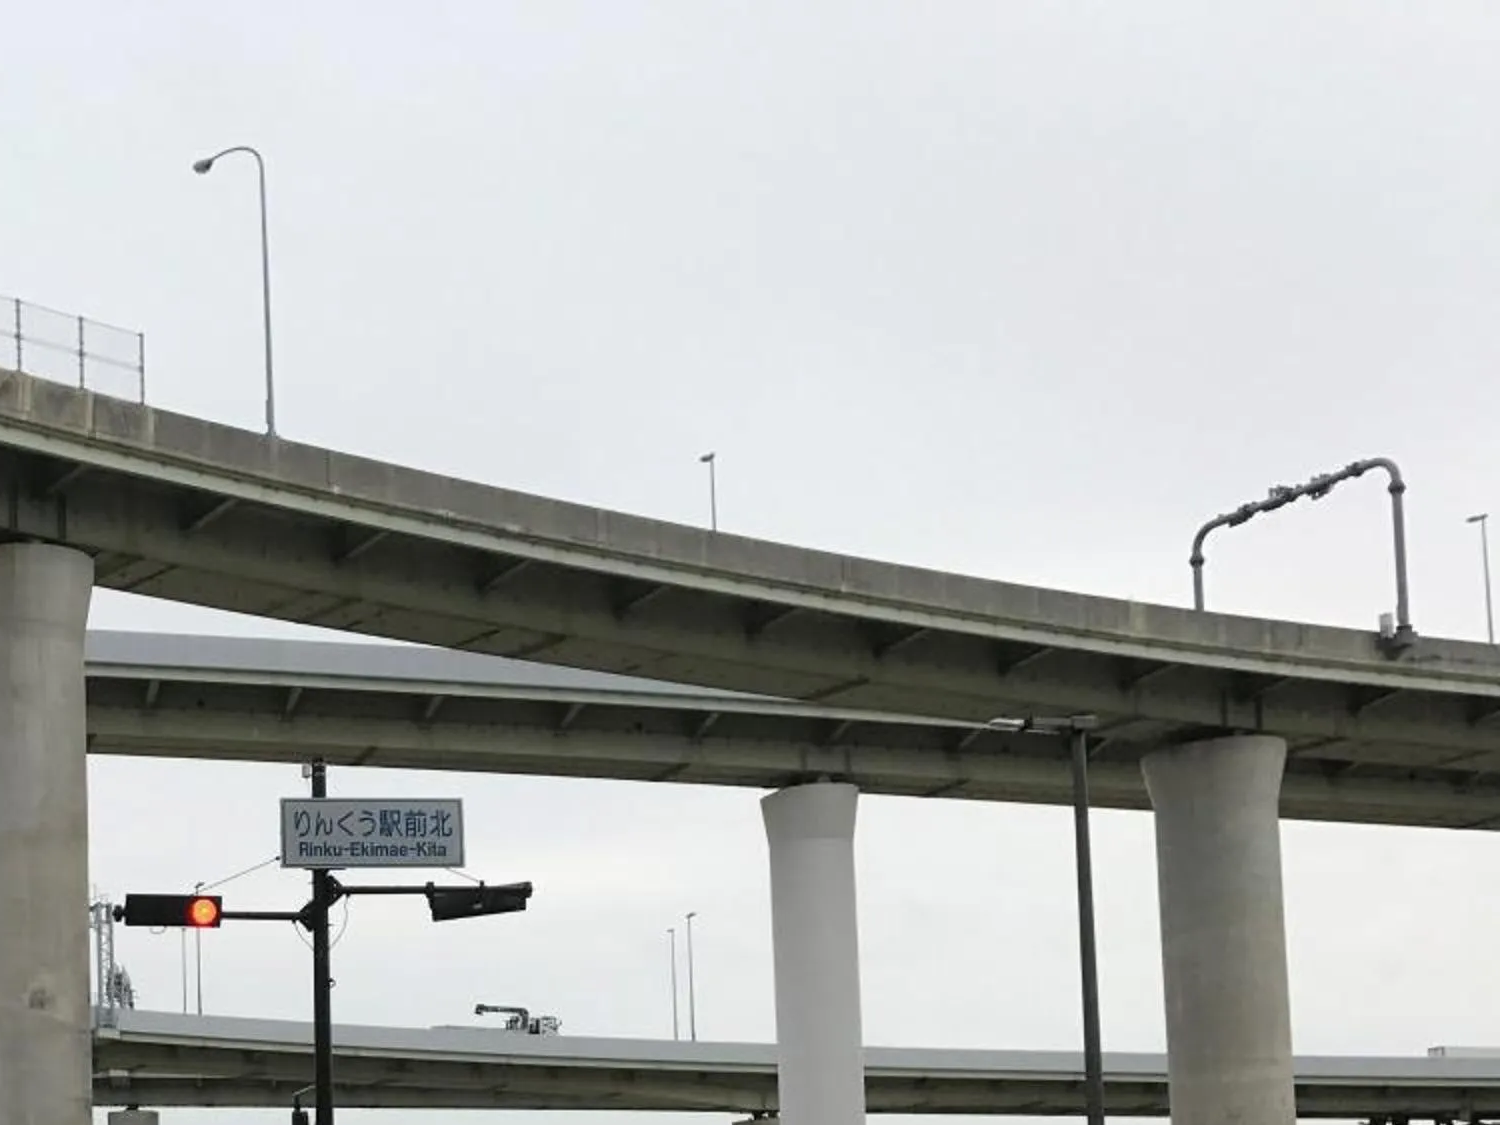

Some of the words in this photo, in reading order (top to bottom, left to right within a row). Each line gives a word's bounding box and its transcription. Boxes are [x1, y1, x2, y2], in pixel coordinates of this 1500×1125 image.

[293, 809, 453, 838] りんくう駅前北
[299, 841, 448, 857] Rinku-Ekimae-Kita
